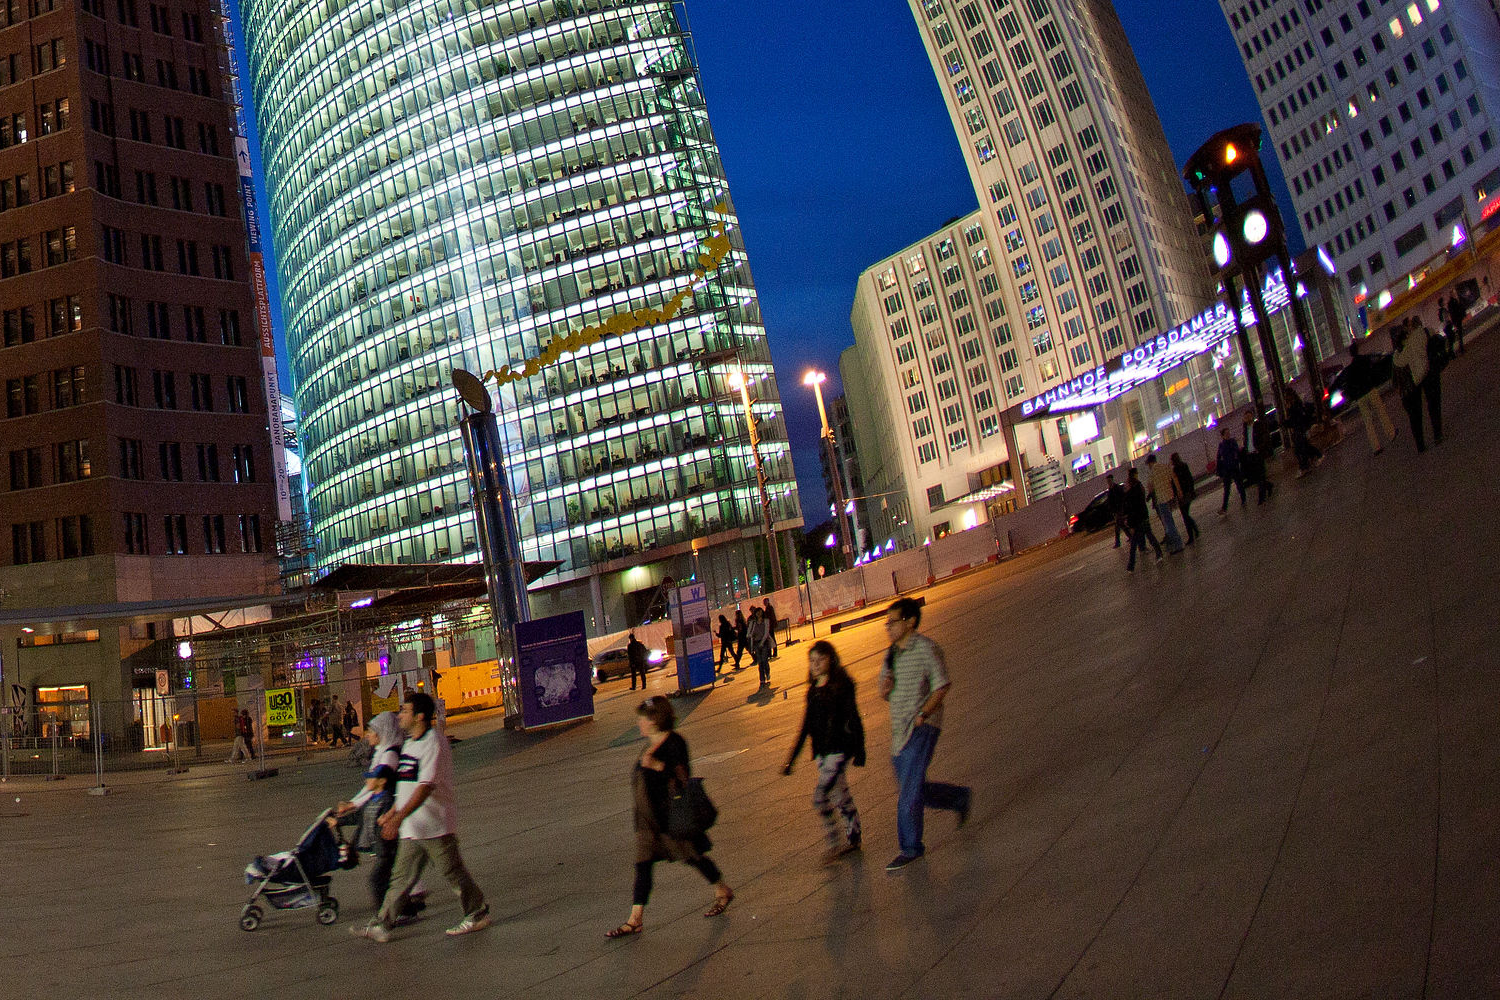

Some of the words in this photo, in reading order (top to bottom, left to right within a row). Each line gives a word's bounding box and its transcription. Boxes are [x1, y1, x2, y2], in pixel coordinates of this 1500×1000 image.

[1022, 366, 1107, 416] BAHNHOF
[1122, 303, 1228, 368] POTSDAMER
[269, 692, 293, 710] U30
